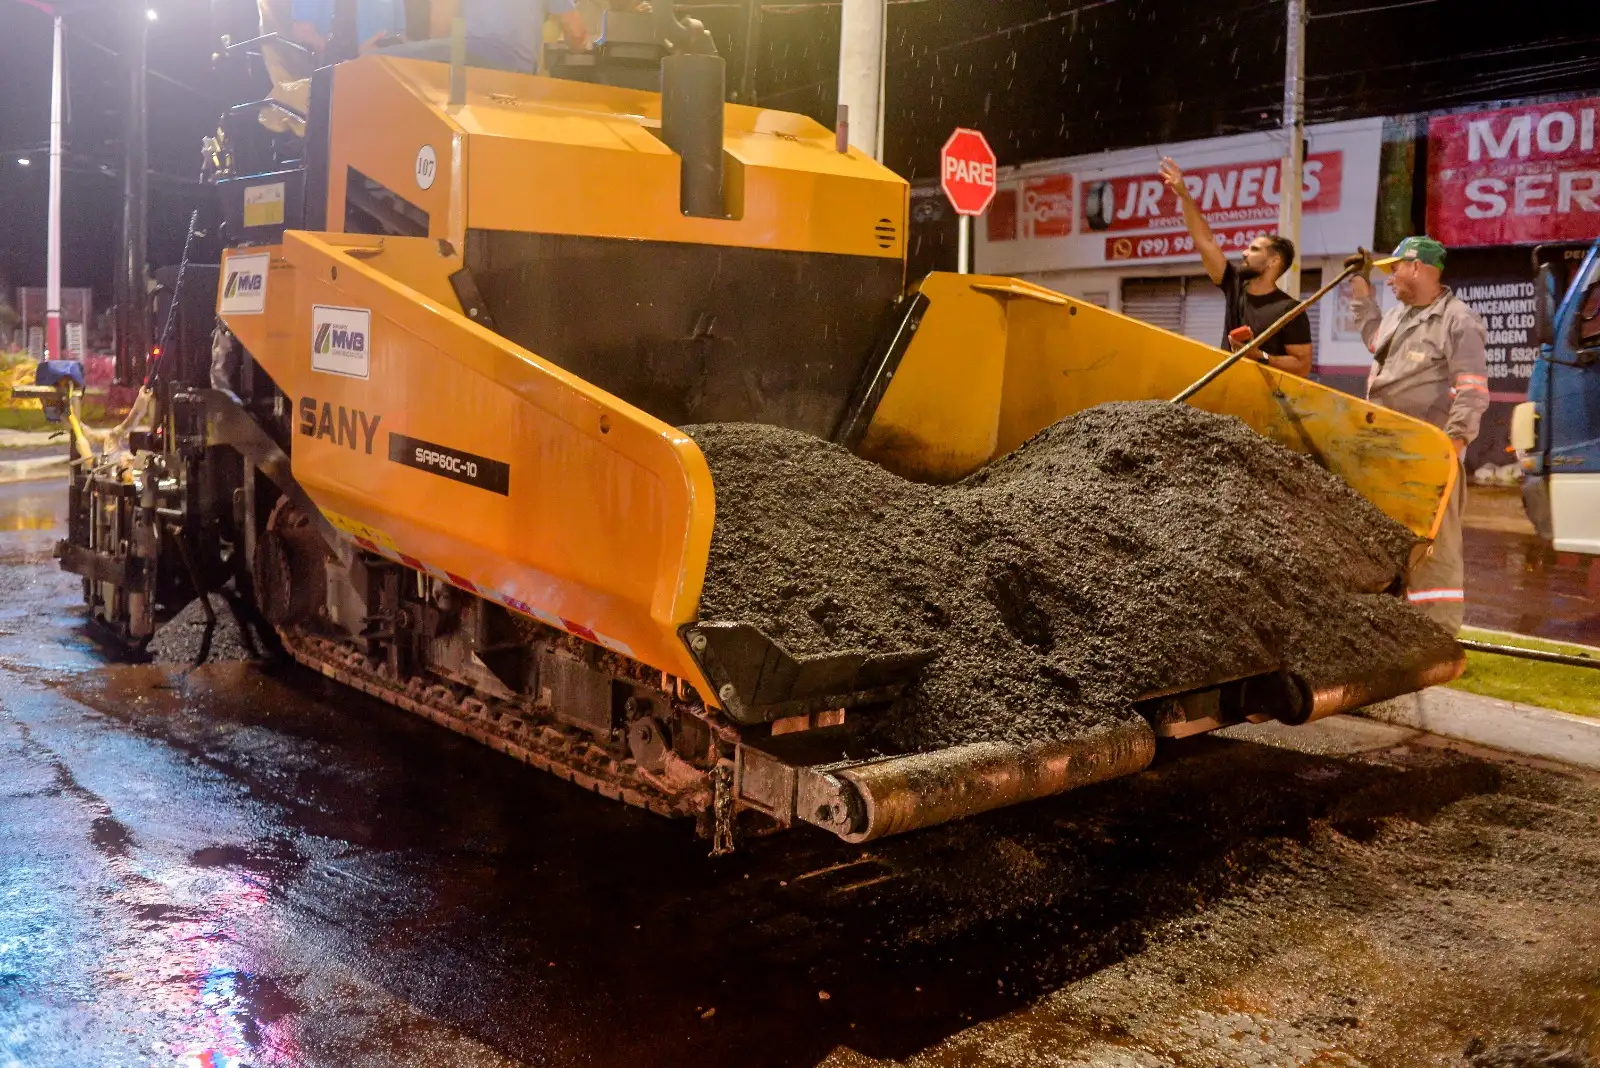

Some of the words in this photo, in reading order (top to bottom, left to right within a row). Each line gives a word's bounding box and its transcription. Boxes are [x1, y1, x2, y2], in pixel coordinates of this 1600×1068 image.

[418, 157, 434, 177] 107
[946, 156, 993, 186] PARE
[1117, 180, 1164, 219] JR
[1137, 238, 1169, 257] (99)
[238, 274, 262, 291] MVB
[1456, 282, 1535, 301] ALINHAMENTO
[1507, 312, 1535, 329] ÓLEO
[332, 329, 365, 352] MVB
[300, 397, 381, 455] SANY
[415, 447, 477, 478] SAP60C-10
